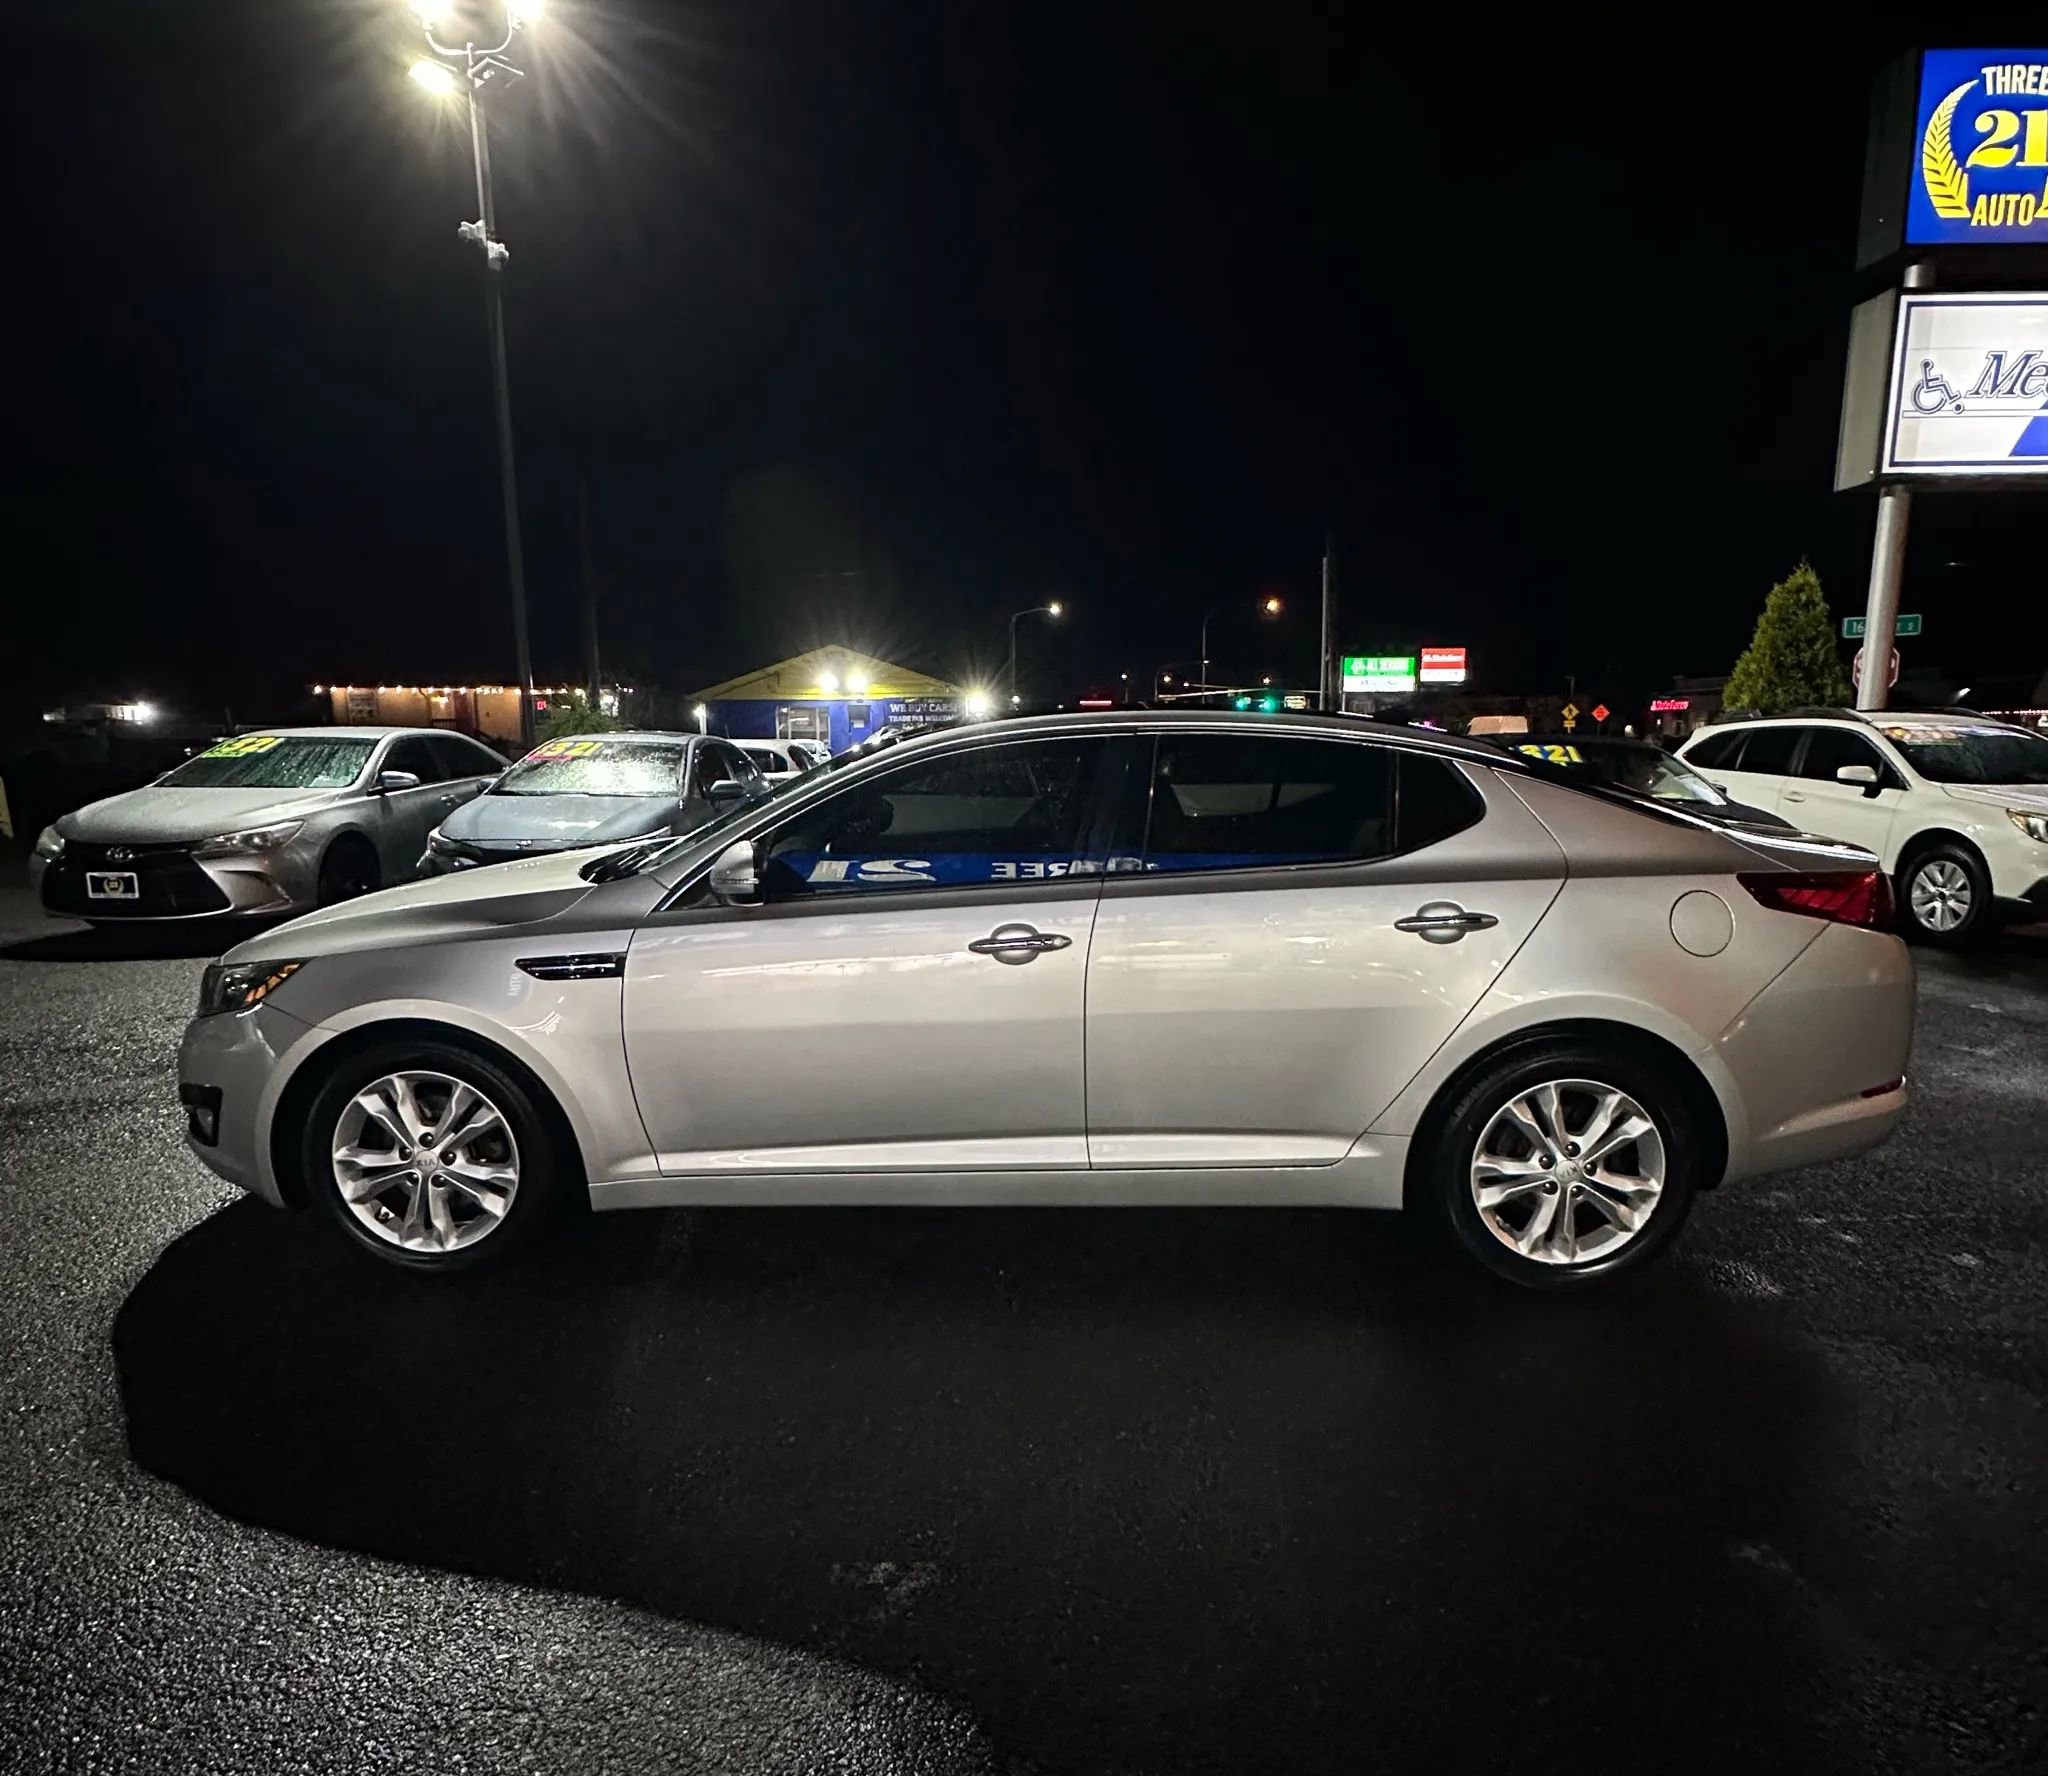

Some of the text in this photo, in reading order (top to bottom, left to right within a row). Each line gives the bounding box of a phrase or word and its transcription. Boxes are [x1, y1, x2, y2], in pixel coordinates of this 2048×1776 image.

[1981, 64, 2048, 96] THREE
[1965, 109, 2048, 168] 21
[1970, 193, 2036, 227] AUTO
[1963, 350, 2048, 399] Me
[890, 704, 906, 712] WE
[908, 704, 927, 712] BUY
